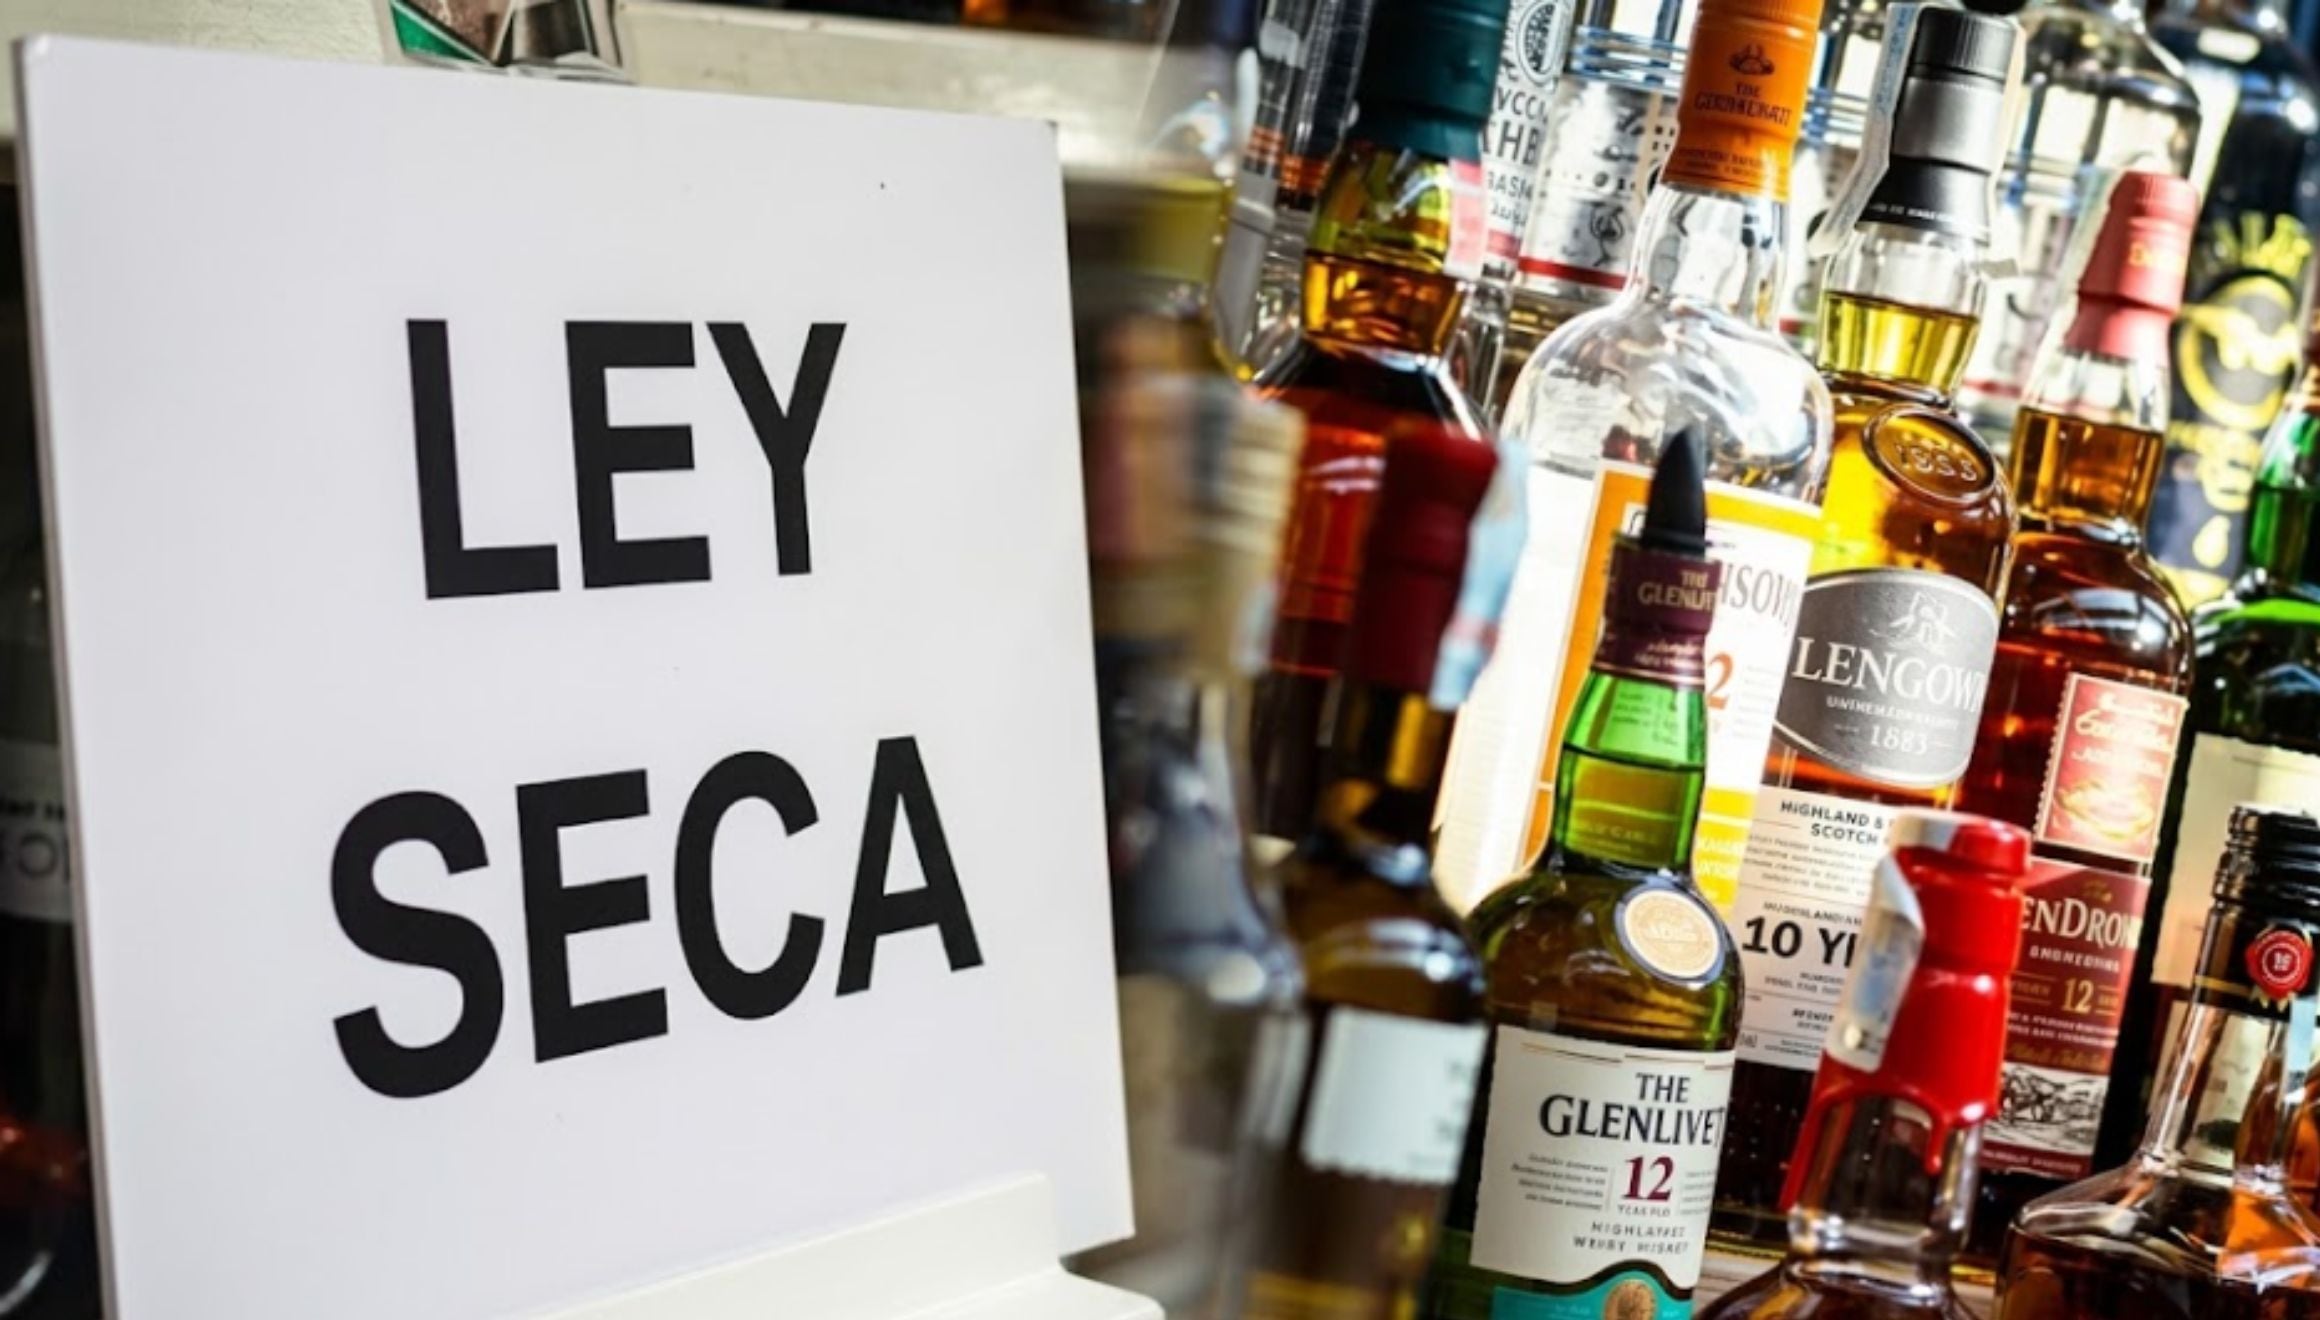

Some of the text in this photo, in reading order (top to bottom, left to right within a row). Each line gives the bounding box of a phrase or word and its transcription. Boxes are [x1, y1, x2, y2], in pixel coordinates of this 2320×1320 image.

[405, 318, 848, 599] LEY
[329, 734, 985, 1100] SECA
[1741, 915, 1804, 960] 10
[2061, 977, 2095, 1015] 12
[1635, 1071, 1691, 1104] THE
[1621, 1154, 1675, 1202] 12
